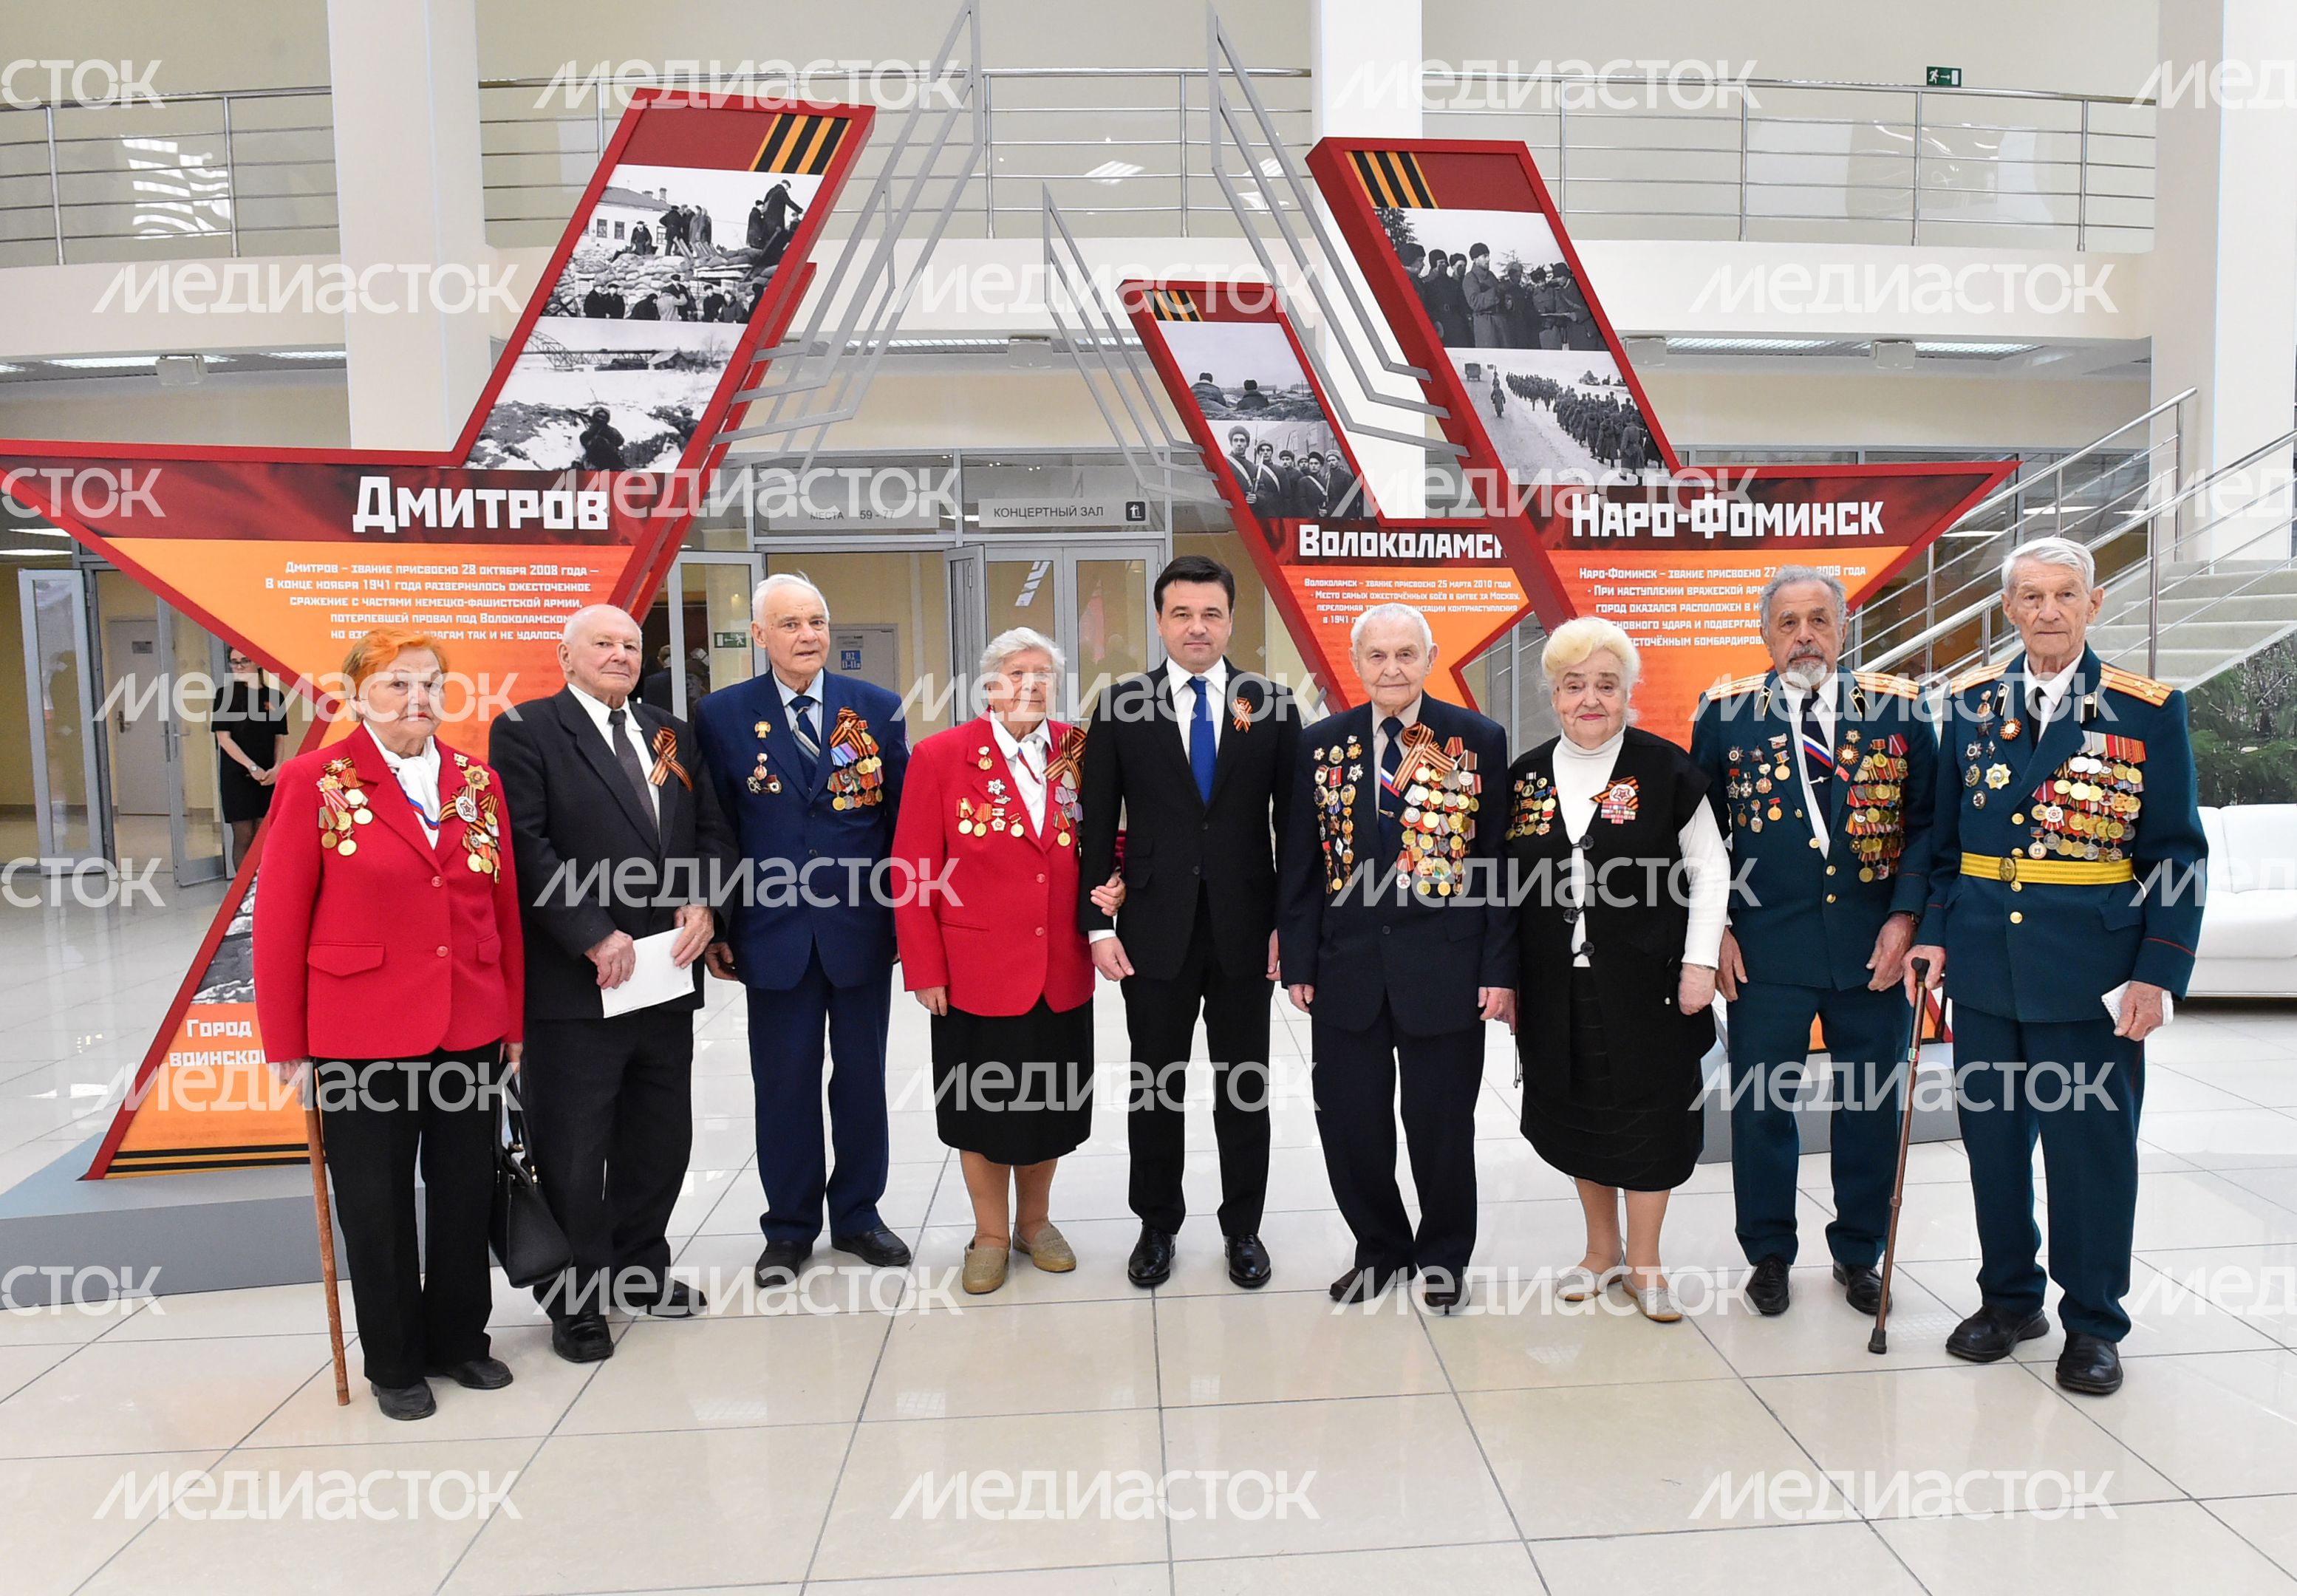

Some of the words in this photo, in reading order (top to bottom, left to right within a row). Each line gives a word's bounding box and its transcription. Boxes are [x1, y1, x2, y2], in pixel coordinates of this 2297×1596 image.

[810, 511, 844, 519] МЕСТА
[859, 510, 873, 519] 59
[883, 510, 895, 519] 77
[994, 505, 1077, 518] КОНЦЕРТНЫЙ
[1080, 507, 1104, 516] ЗАЛ
[462, 564, 476, 575] 28
[530, 565, 558, 576] 2008
[1764, 567, 1776, 577] 27
[363, 579, 391, 590] 1941
[1438, 579, 1447, 587] 25
[1473, 579, 1492, 588] 2010
[1331, 615, 1349, 624] 1941
